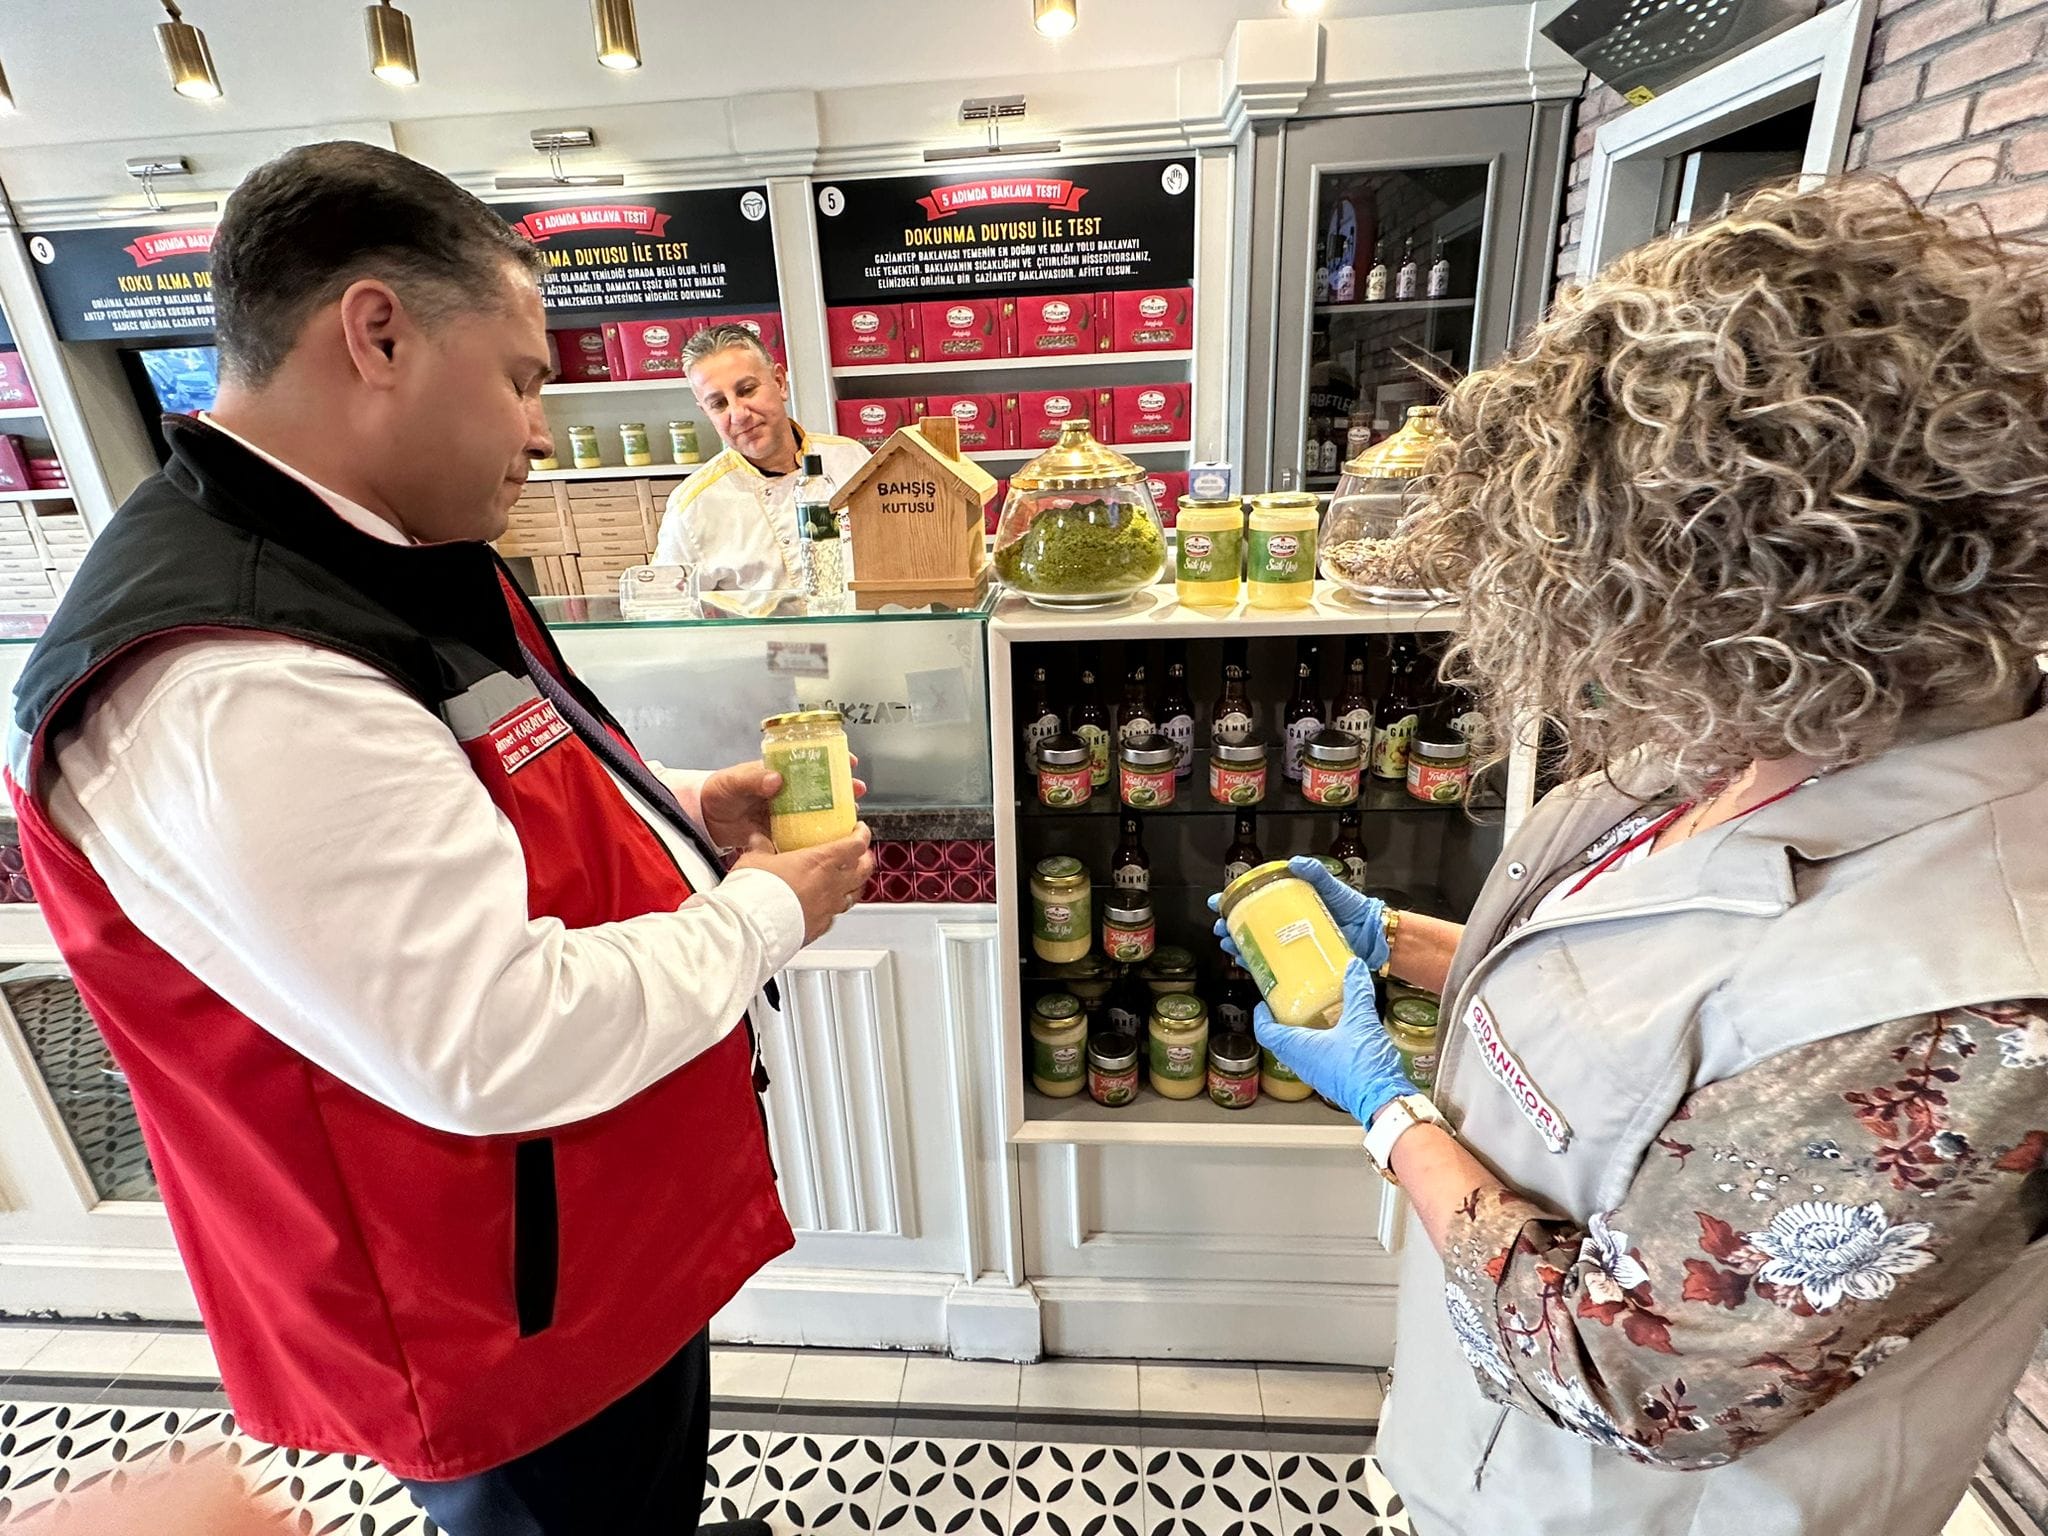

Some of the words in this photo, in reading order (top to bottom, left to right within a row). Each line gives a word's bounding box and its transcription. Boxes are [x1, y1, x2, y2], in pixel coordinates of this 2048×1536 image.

[828, 193, 835, 210] 5
[942, 194, 949, 206] 5
[952, 190, 989, 205] ADIMDA
[990, 185, 1033, 199] BAKLAVA
[1036, 184, 1061, 198] TESTİ
[536, 219, 543, 231] 5
[545, 214, 578, 229] ADIMDA
[581, 211, 621, 226] BAKLAVA
[622, 209, 647, 225] TESTİ
[905, 225, 976, 247] DOKUNMA
[981, 221, 1036, 242] DUYUSU
[1042, 216, 1063, 238] İLE
[1068, 217, 1102, 236] TEST
[37, 242, 48, 258] 3
[574, 246, 628, 266] DUYUSU
[632, 242, 653, 262] İLE
[656, 242, 688, 260] TEST
[874, 251, 917, 264] GAZİANTEP
[918, 250, 960, 262] BAKLAVASI
[962, 246, 996, 259] YEMENİN
[998, 246, 1008, 257] EN
[1010, 244, 1036, 256] DOĞRU
[1038, 244, 1048, 255] VE
[1050, 242, 1074, 254] KOLAY
[1076, 241, 1095, 252] YOLU
[1098, 238, 1140, 251] BAKLAVAYI
[561, 272, 590, 283] OLARAK
[591, 268, 626, 280] YENİLDİĞİ
[627, 268, 655, 279] SIRADA
[656, 264, 676, 277] BELLİ
[712, 262, 726, 273] BİR
[864, 267, 881, 277] ELLE
[883, 263, 922, 276] YEMEKTİR.
[924, 262, 973, 274] BAKLAVANIN
[974, 258, 1020, 271] SICAKLIĞINI
[1022, 258, 1032, 268] VE
[118, 276, 153, 292] KOKU
[157, 272, 192, 290] ALMA
[547, 284, 573, 295] AĞIZDA
[606, 281, 641, 292] DAMAKTA
[642, 278, 663, 291] EŞSİZ
[664, 277, 677, 289] BİR
[679, 278, 692, 288] TAT
[878, 276, 919, 289] ELİNİZDEKİ
[920, 274, 955, 286] ORİJİNAL
[957, 272, 970, 285] BİR
[975, 272, 1017, 284] GAZİANTEP
[1078, 266, 1104, 278] AFİYET
[558, 296, 602, 307] MALZEMELER
[604, 292, 643, 304] SAYESİNDE
[644, 290, 679, 303] MİDENİZE
[878, 479, 936, 498] BAHŞİŞ
[882, 502, 935, 514] KUTUSU
[1032, 724, 1058, 737] GANN
[1164, 726, 1191, 737] GANN
[1340, 720, 1368, 731] GANN
